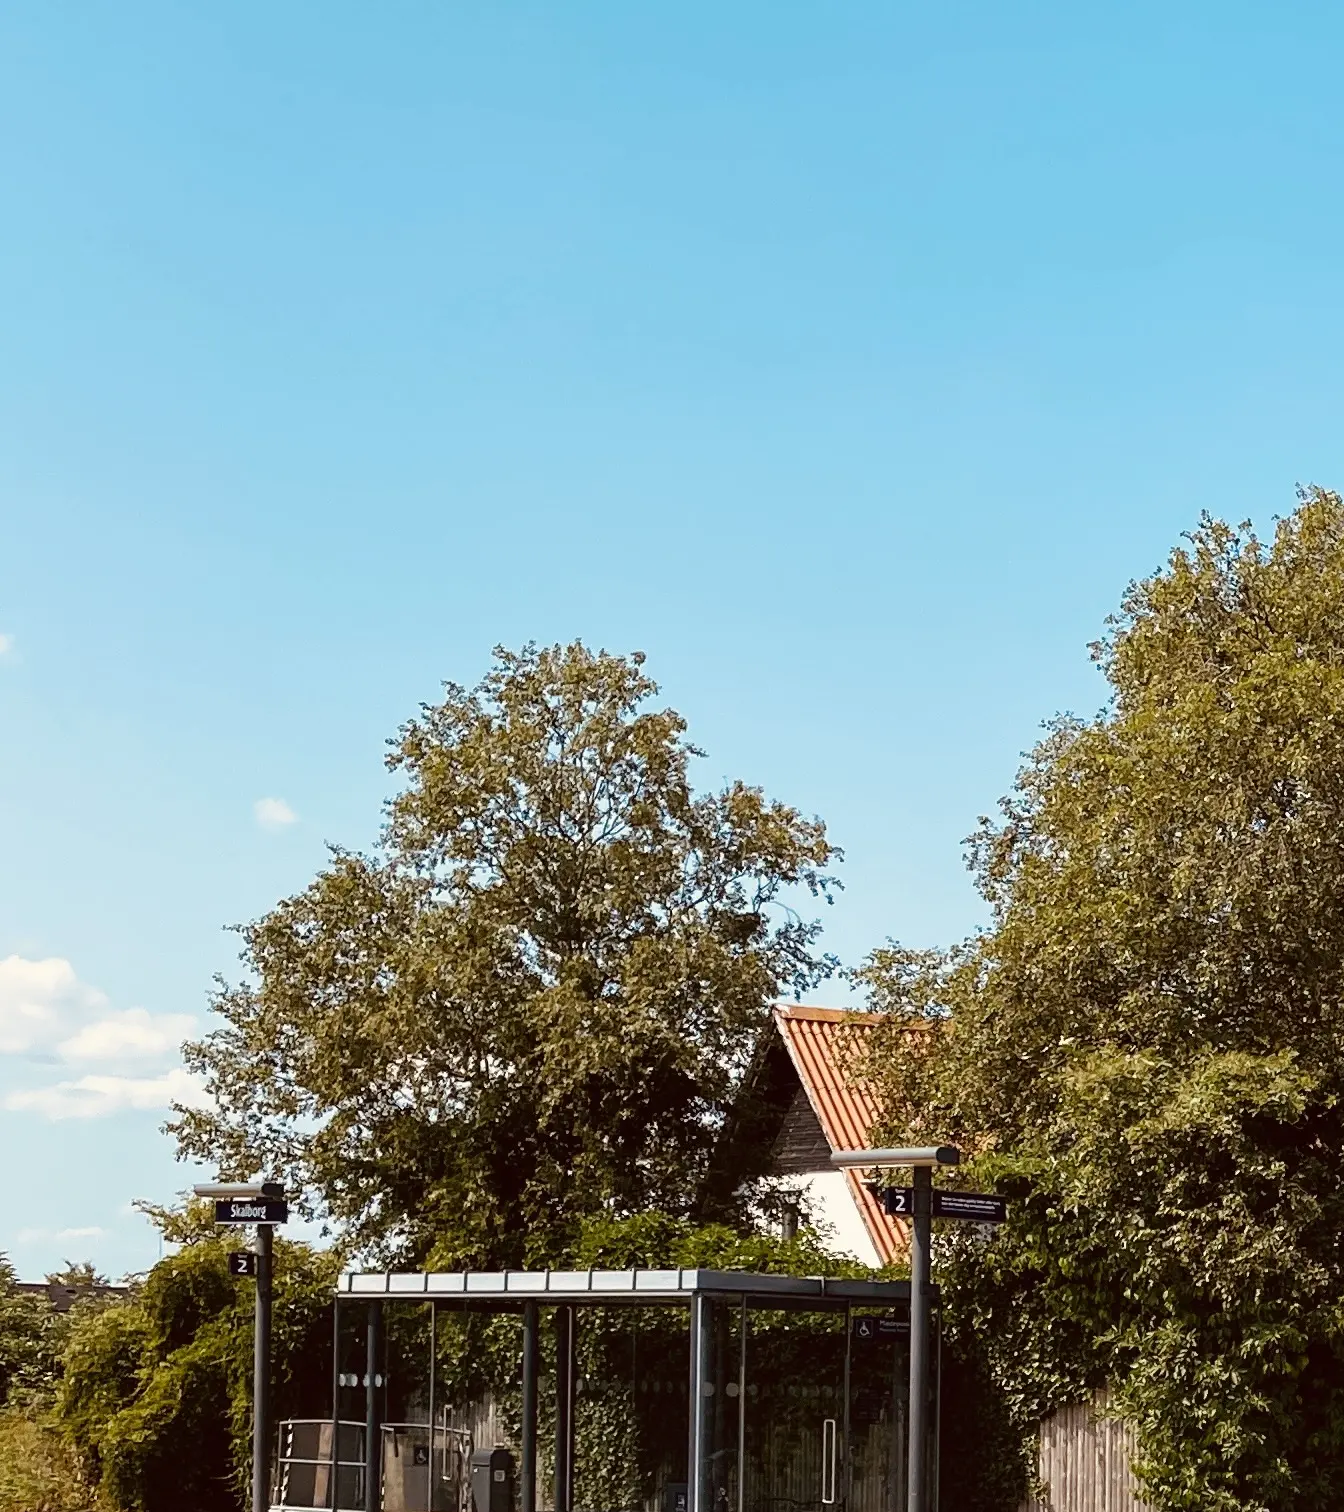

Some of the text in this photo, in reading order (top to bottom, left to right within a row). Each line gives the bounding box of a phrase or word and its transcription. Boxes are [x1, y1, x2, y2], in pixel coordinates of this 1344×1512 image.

[230, 1203, 267, 1219] Skalborg
[895, 1195, 906, 1212] 2
[237, 1259, 248, 1273] 2
